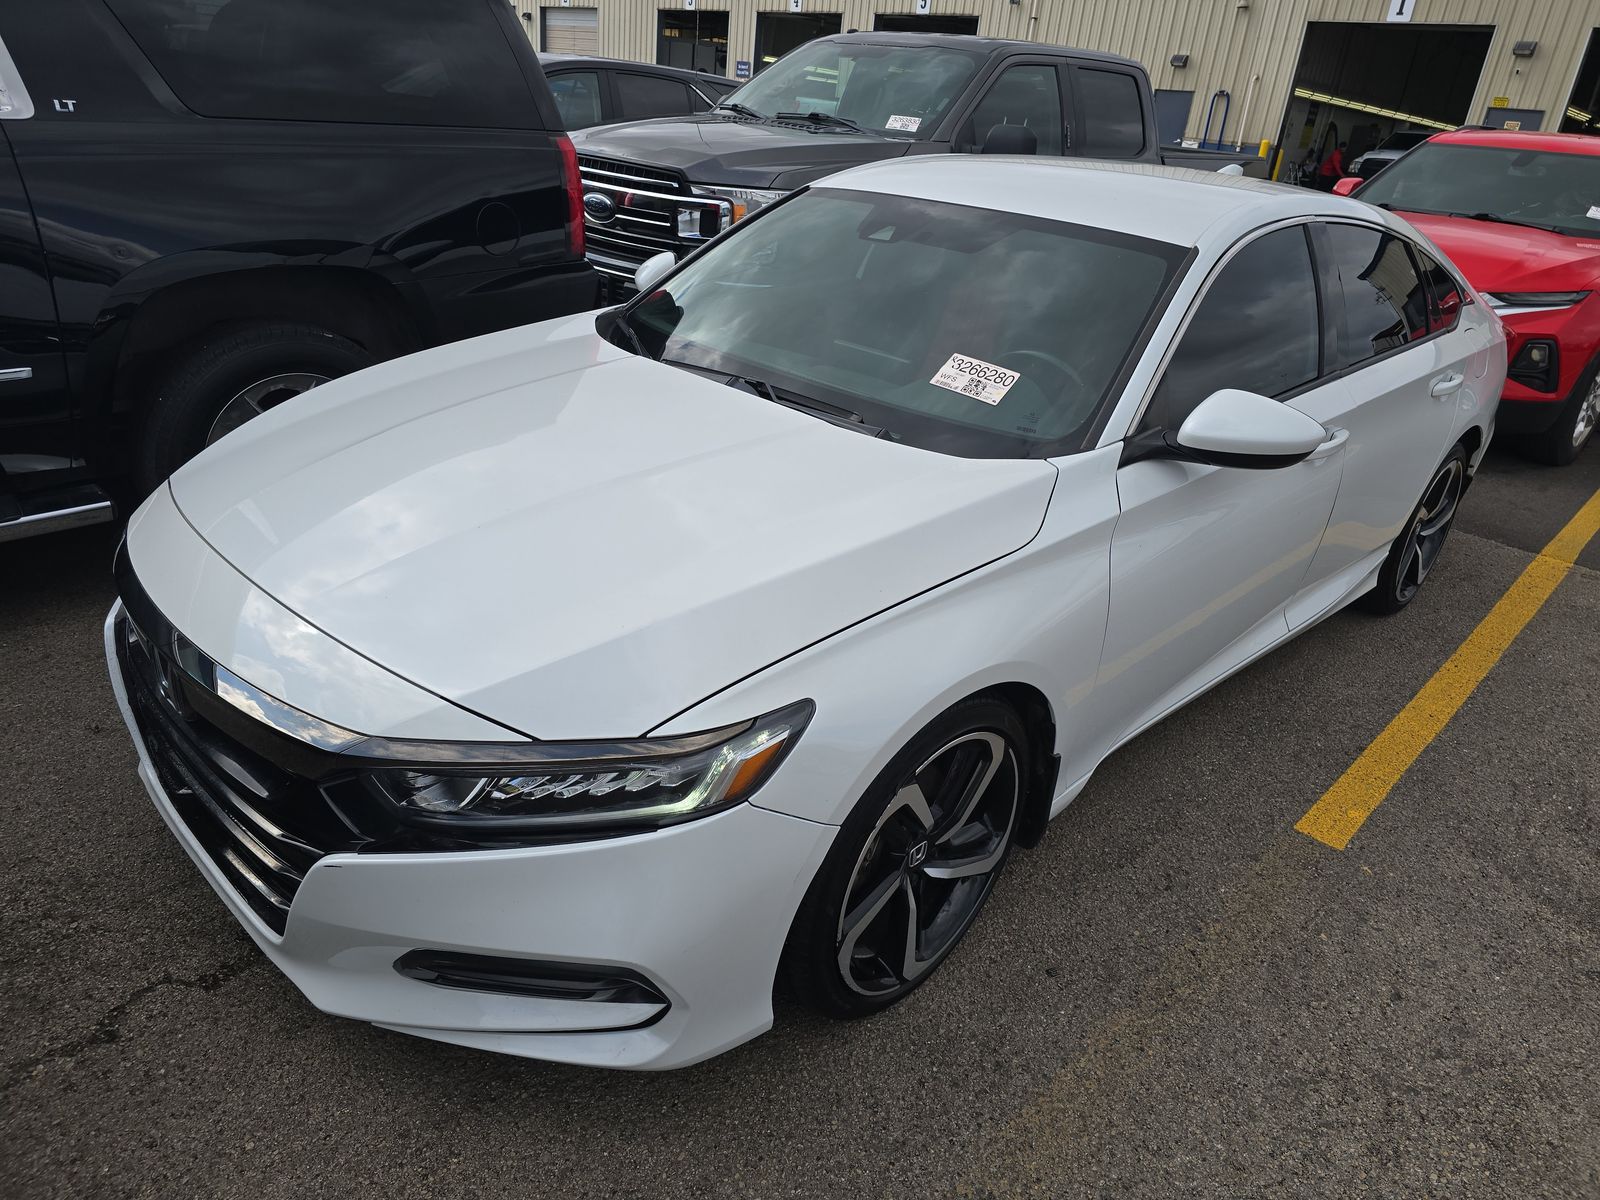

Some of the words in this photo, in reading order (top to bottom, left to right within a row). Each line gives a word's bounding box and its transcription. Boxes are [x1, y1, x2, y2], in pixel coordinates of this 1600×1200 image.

[53, 99, 77, 112] LT
[940, 372, 958, 383] WFS
[951, 358, 1015, 387] 3266280
